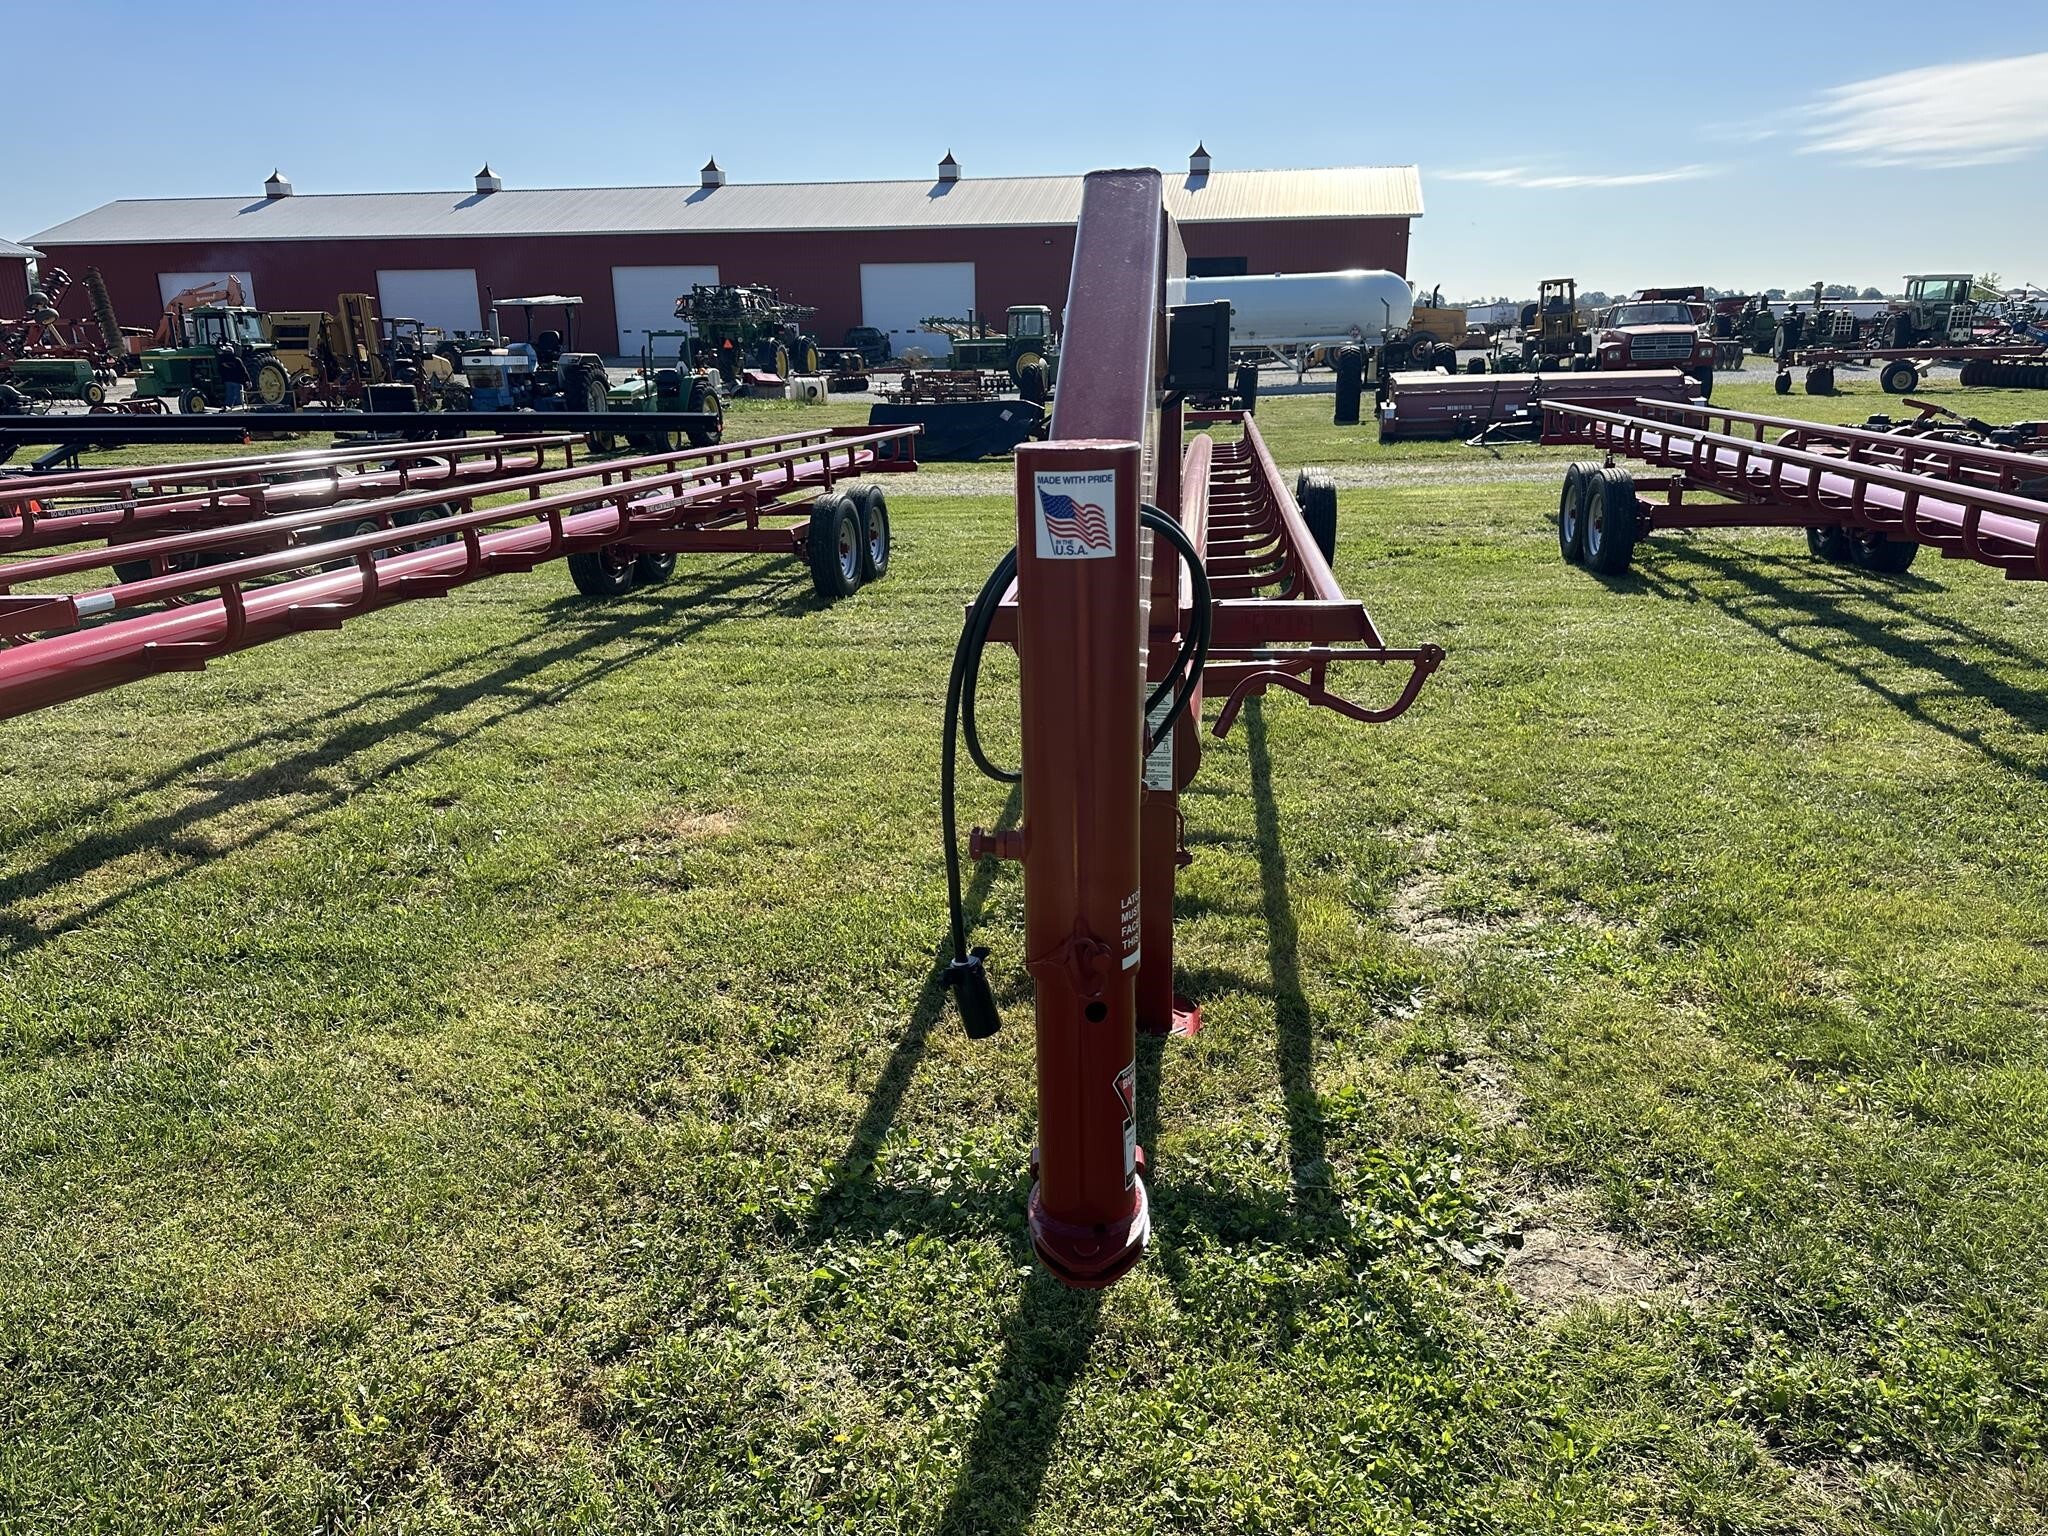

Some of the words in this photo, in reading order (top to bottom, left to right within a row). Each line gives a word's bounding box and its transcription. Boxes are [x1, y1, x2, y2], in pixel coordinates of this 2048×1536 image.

[1037, 475, 1061, 485] MADE
[1063, 475, 1086, 485] WITH
[1087, 474, 1113, 484] PRIDE
[1055, 545, 1088, 555] U.S.A.
[1122, 932, 1139, 950] THIS
